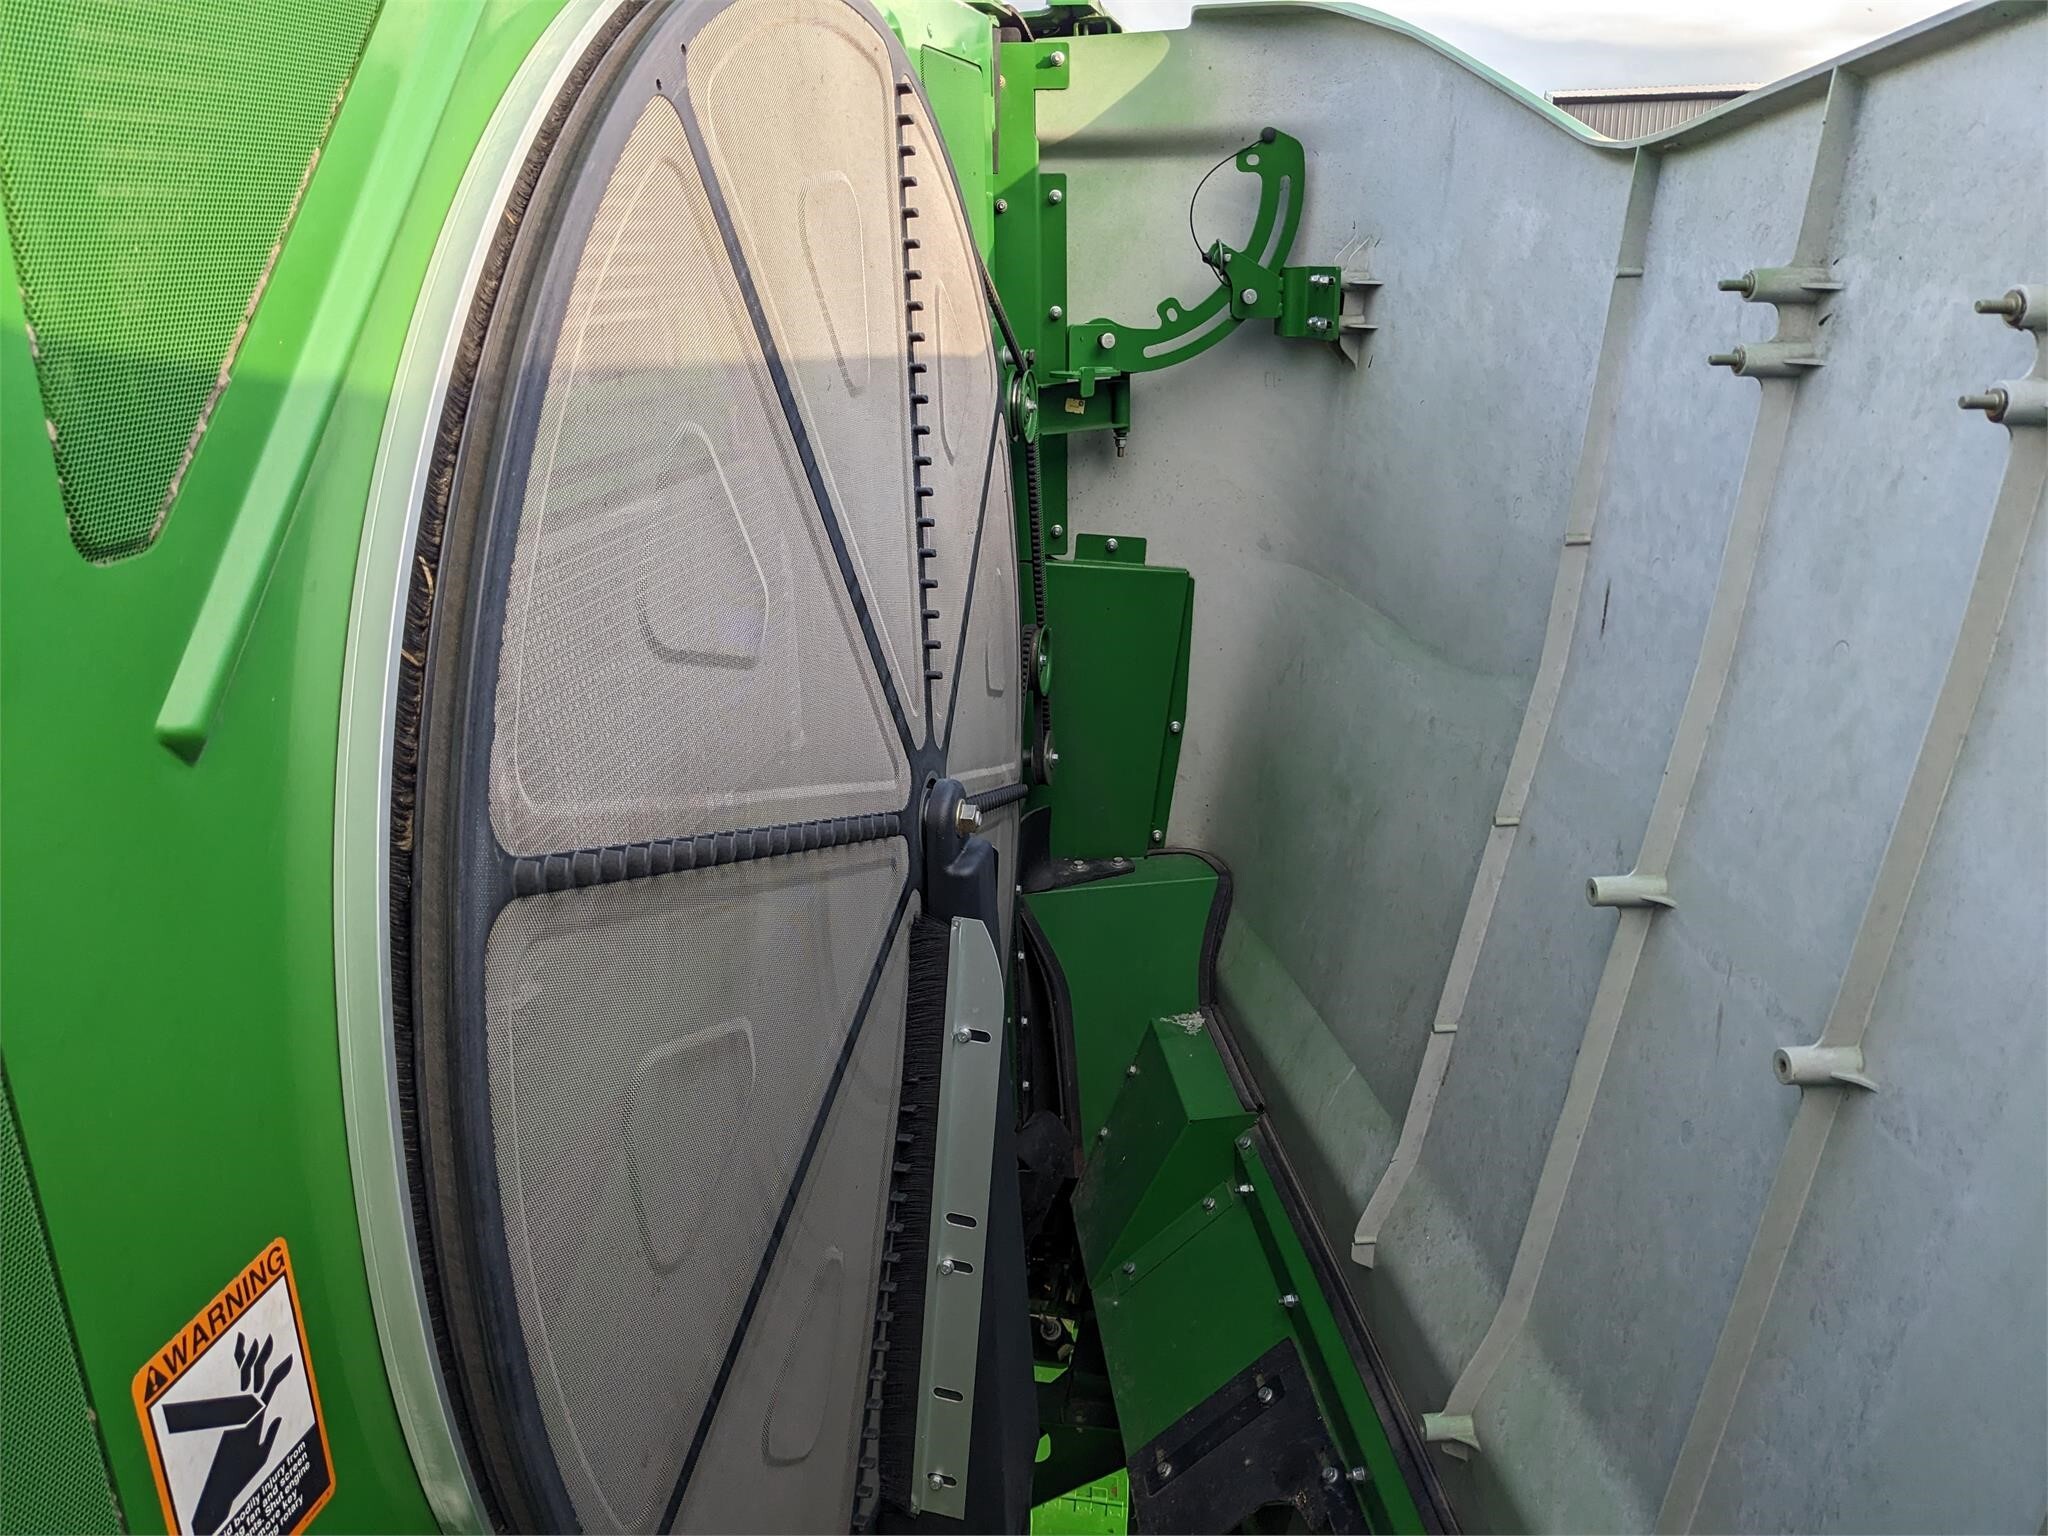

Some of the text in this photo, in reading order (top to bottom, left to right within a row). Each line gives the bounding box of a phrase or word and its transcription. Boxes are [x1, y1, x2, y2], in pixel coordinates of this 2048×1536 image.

[163, 1246, 285, 1375] WARNING
[234, 1493, 260, 1527] bodily
[262, 1464, 285, 1495] injury
[287, 1441, 306, 1466] from
[246, 1508, 261, 1526] fan
[262, 1483, 279, 1508] and
[280, 1452, 308, 1487] screen
[265, 1491, 284, 1517] Shut
[285, 1461, 310, 1494] engine
[280, 1493, 303, 1526] rotary
[282, 1488, 297, 1510] key
